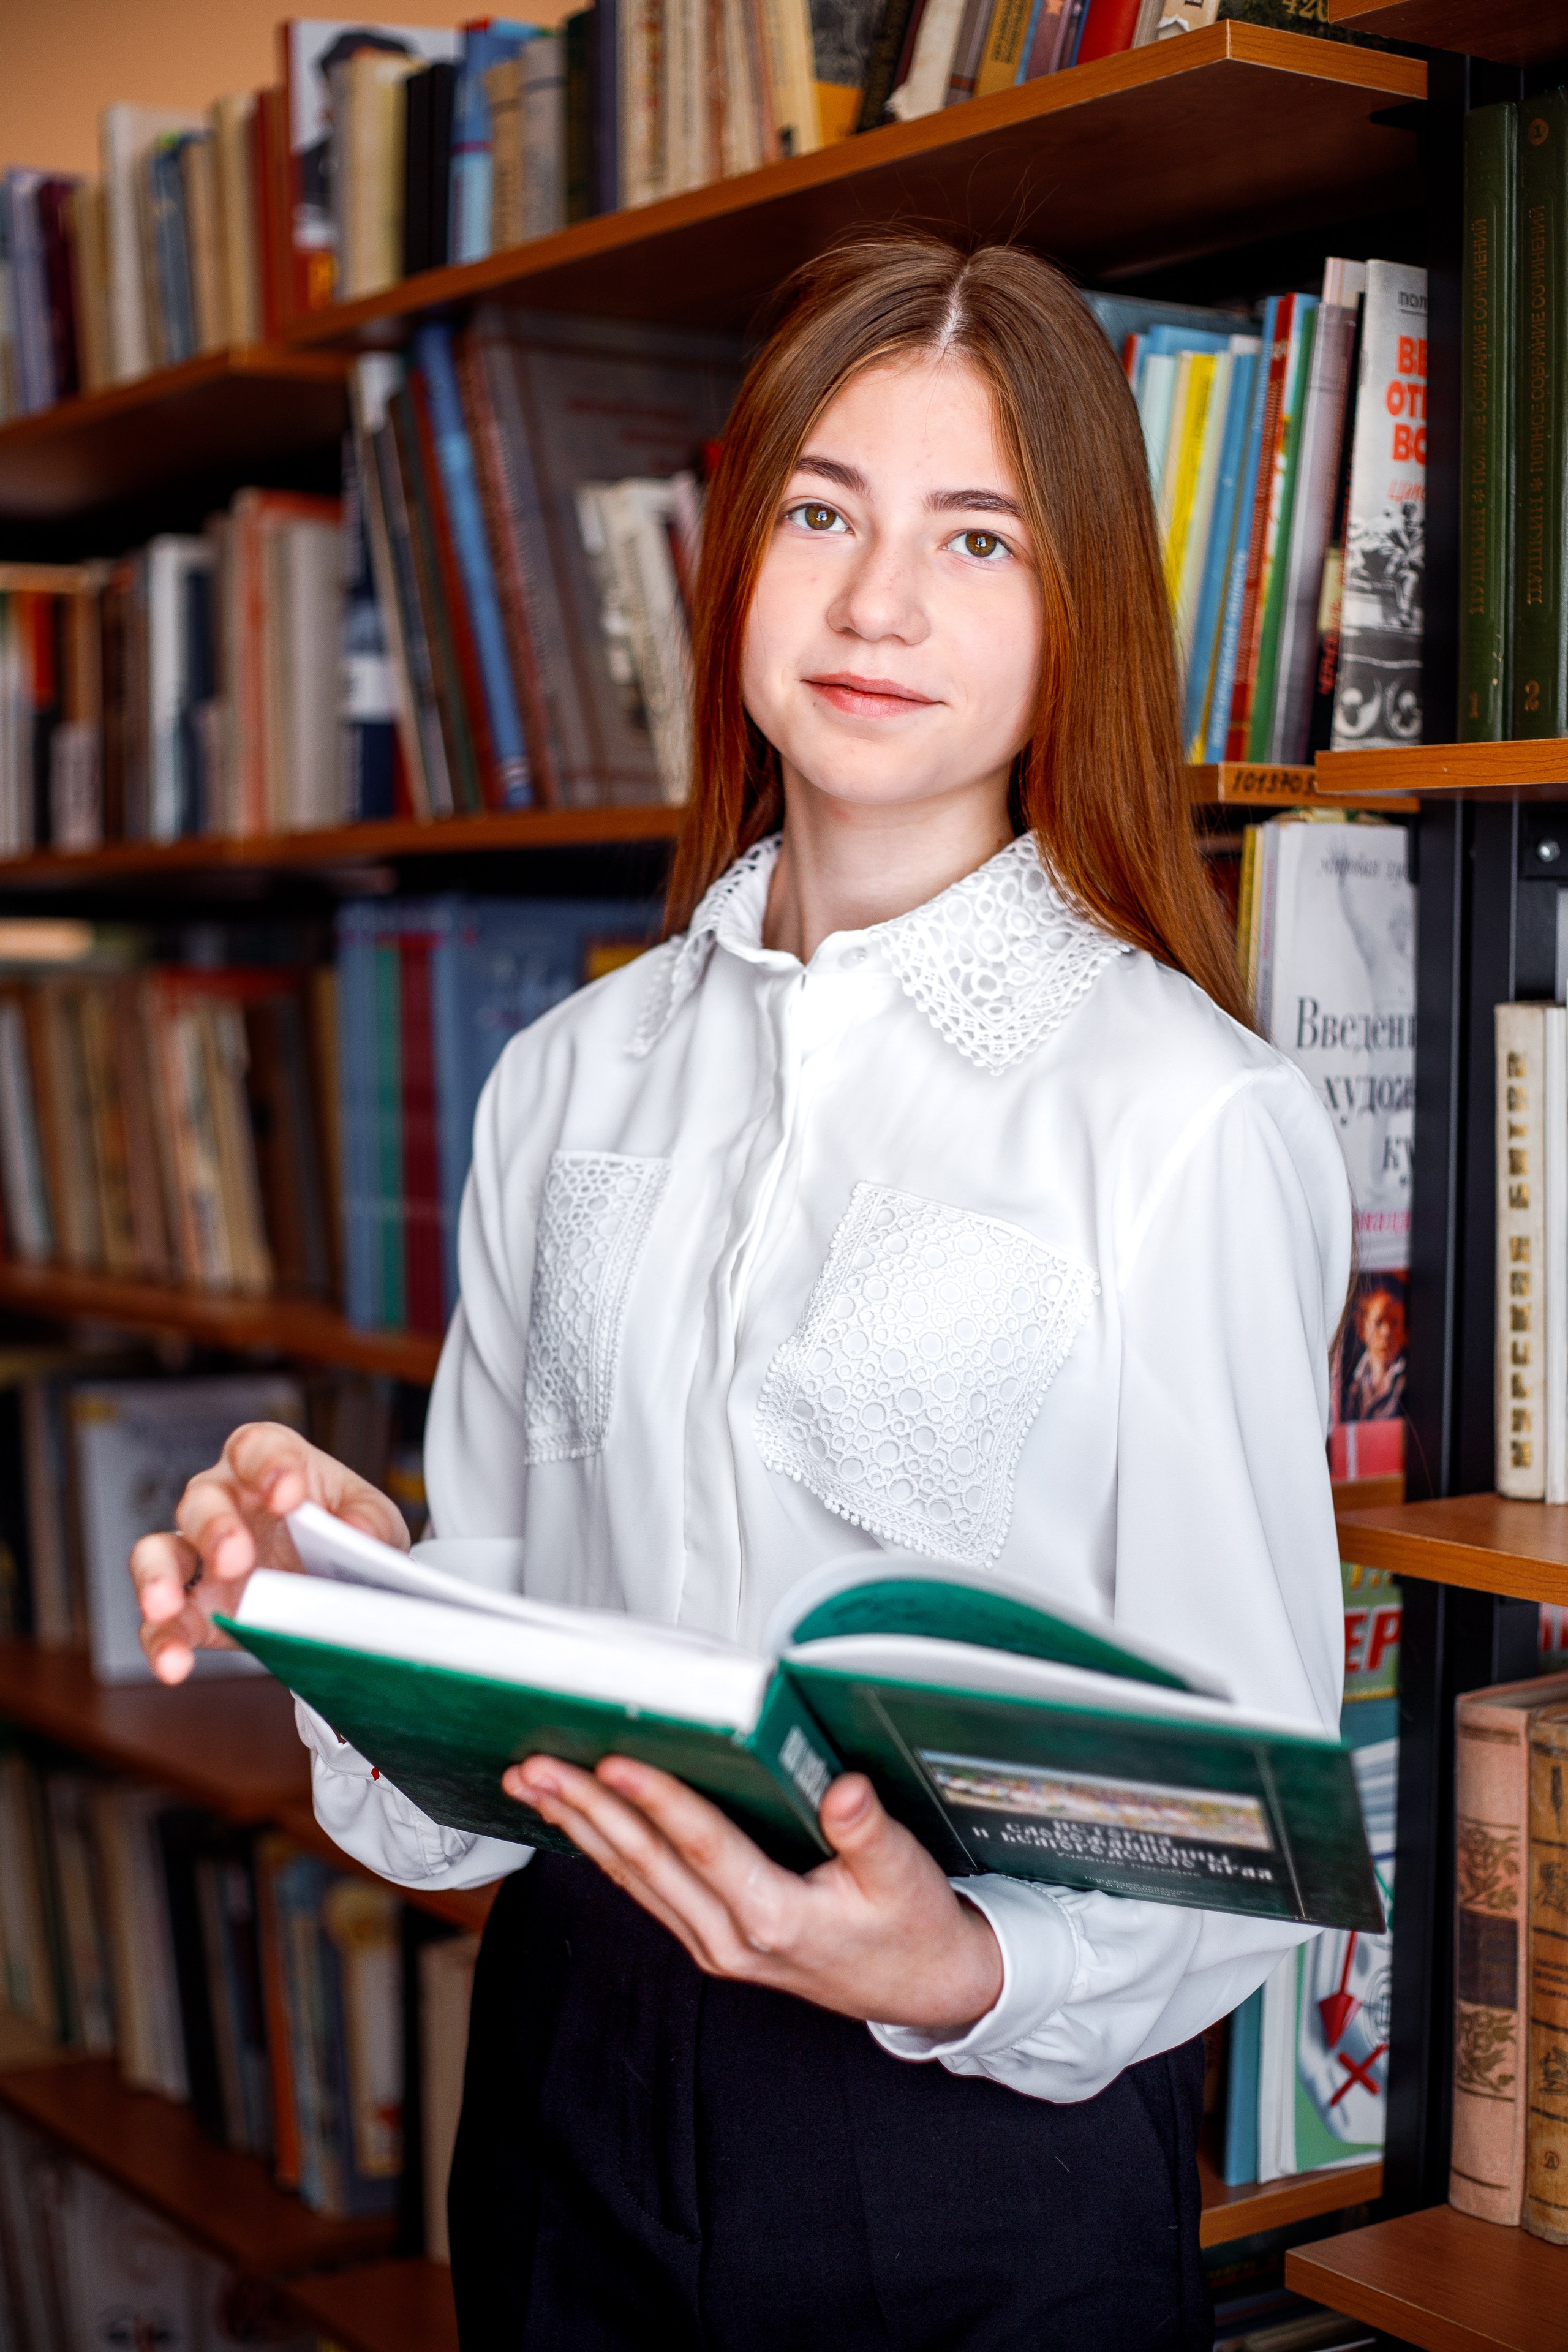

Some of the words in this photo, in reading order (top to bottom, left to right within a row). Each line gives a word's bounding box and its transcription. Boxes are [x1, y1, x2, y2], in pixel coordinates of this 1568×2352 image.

[1471, 219, 1488, 320] СОЧИНЕНИЙ
[1529, 205, 1546, 309] СОЧИНЕНИЙ
[1473, 323, 1487, 413] СОБРАНИЕ
[1531, 311, 1546, 400] СОБРАНИЕ
[1530, 402, 1545, 472] ПОЛНОЕ
[1469, 507, 1486, 614] ПУШКИН
[1526, 495, 1544, 605] ПУШКИН
[1470, 691, 1479, 718] 1
[1524, 680, 1540, 711] 2
[1507, 1050, 1530, 1210] БИТВА
